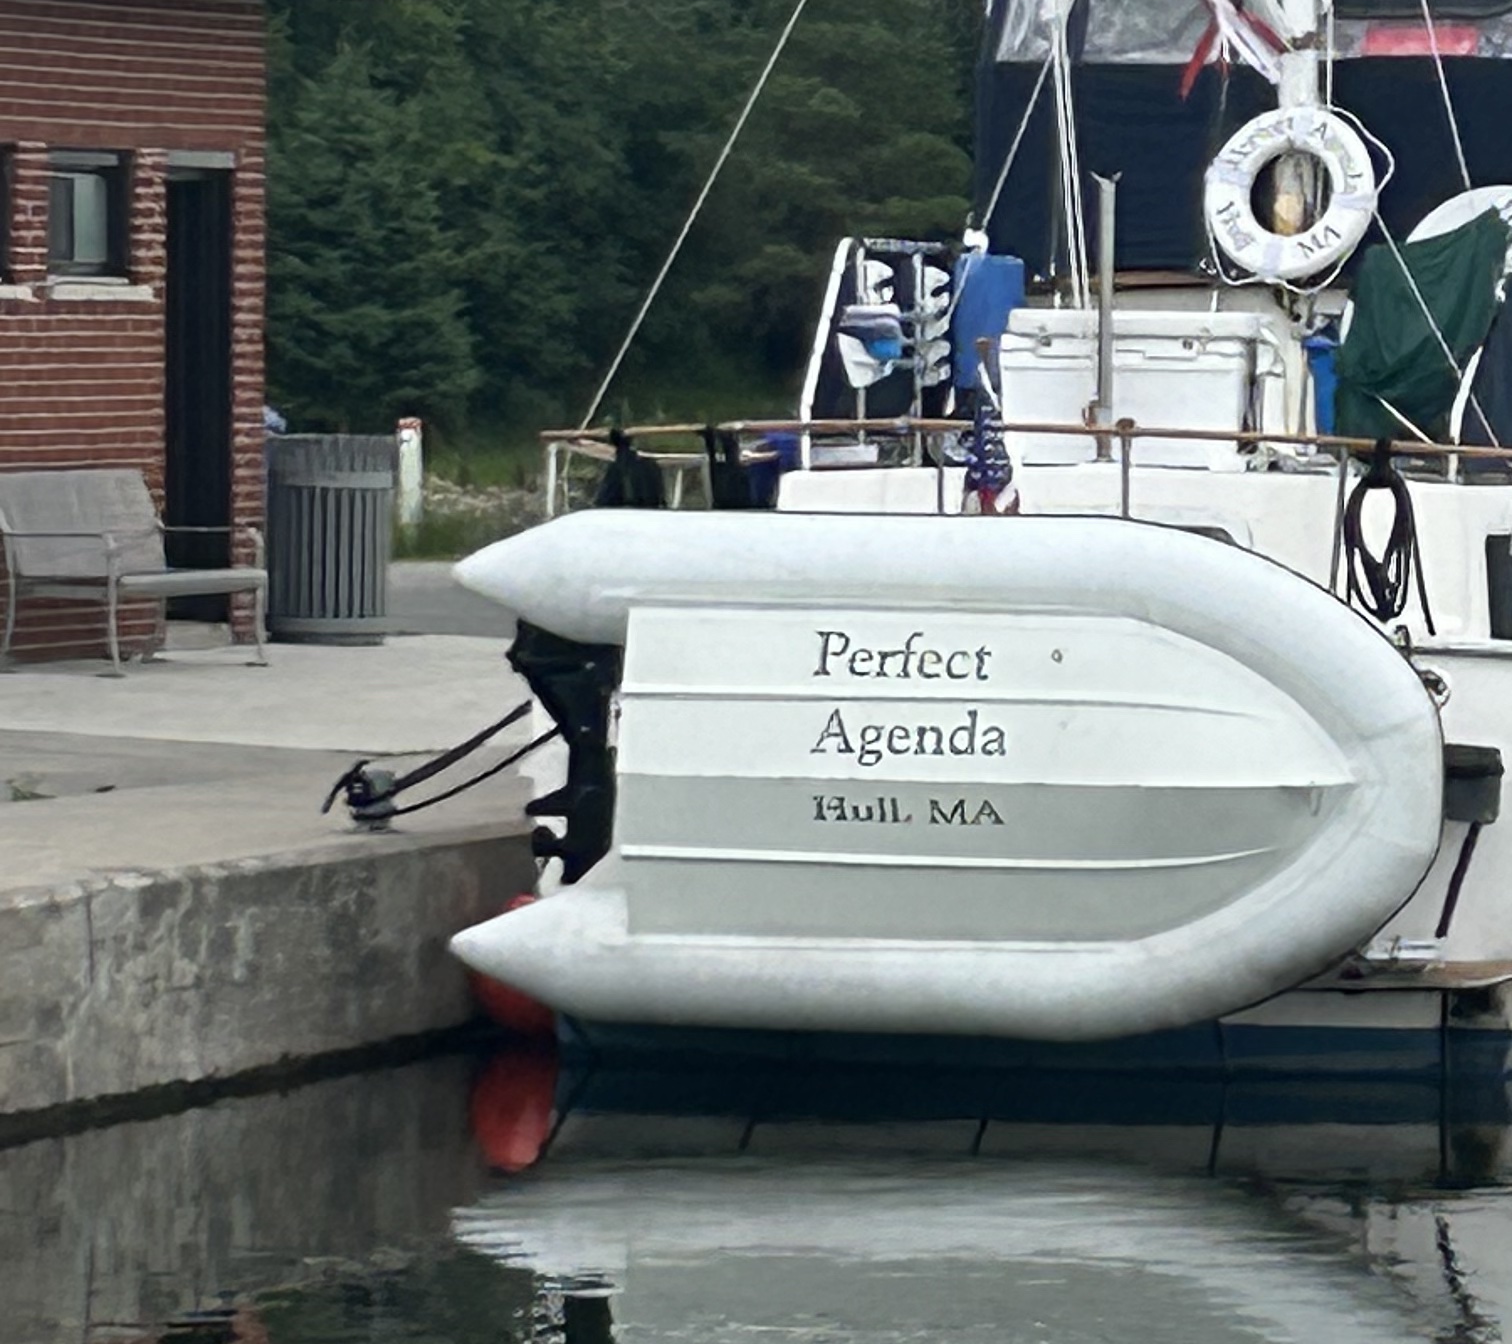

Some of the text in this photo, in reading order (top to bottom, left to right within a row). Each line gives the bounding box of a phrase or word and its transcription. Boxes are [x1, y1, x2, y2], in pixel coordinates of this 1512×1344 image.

[812, 630, 992, 680] Perfect
[810, 707, 1007, 766] Agenda
[928, 798, 1005, 826] MA
